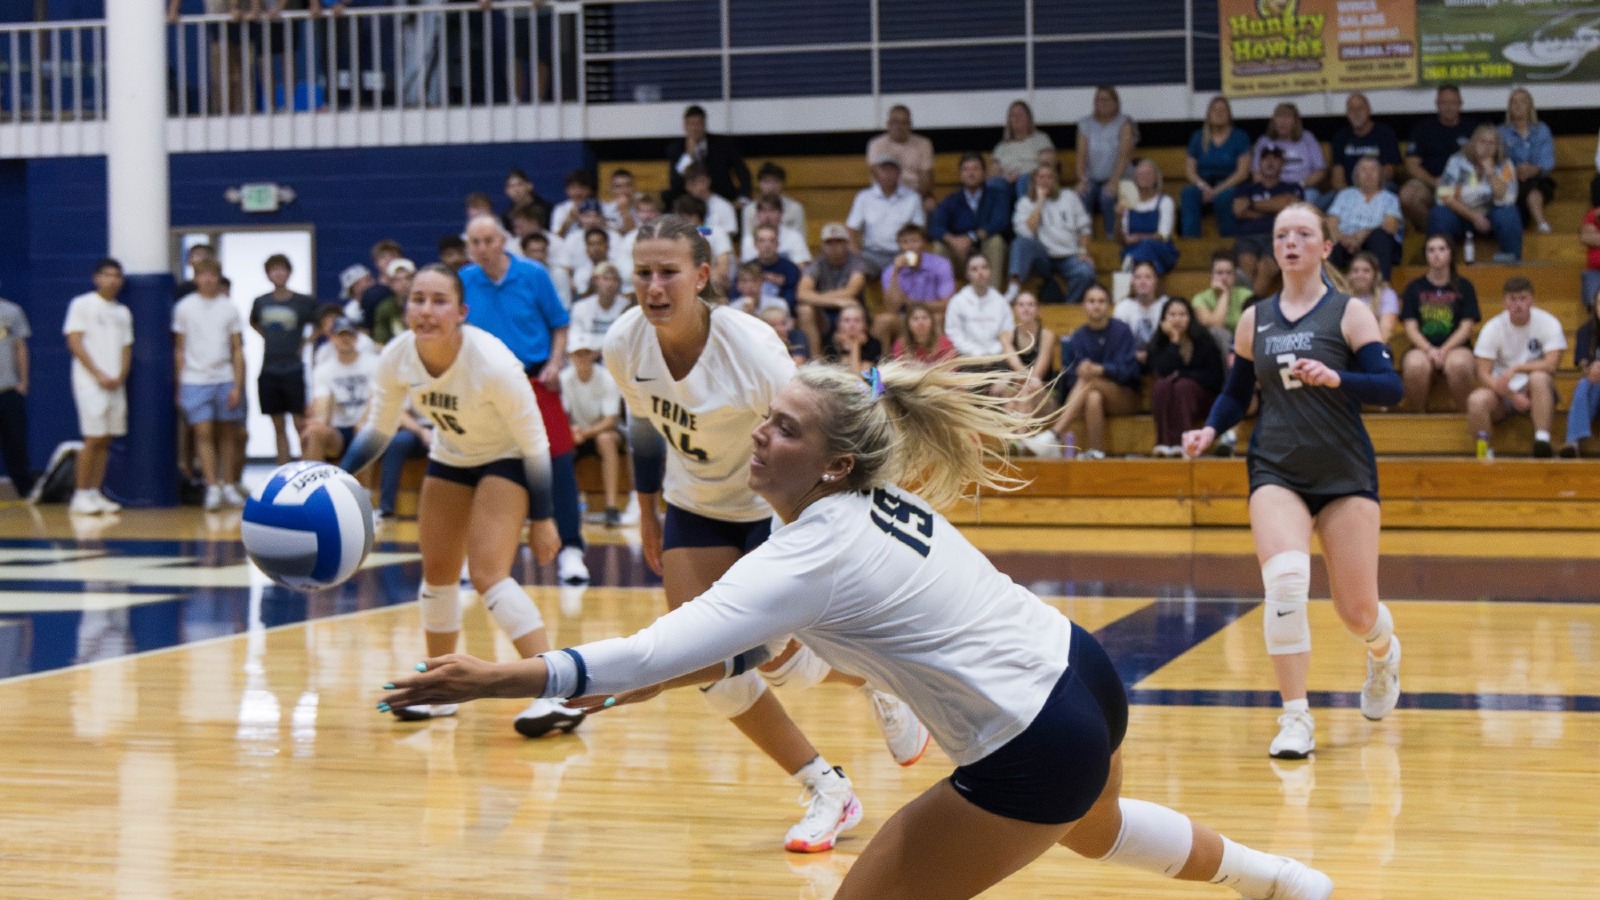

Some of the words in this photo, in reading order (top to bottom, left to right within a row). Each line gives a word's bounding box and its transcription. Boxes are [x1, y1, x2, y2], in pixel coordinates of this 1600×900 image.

[1229, 14, 1325, 41] Hungry
[1265, 331, 1315, 355] TRINE
[1276, 353, 1304, 391] 2
[421, 391, 459, 412] TRINE
[651, 395, 698, 431] TRINE
[431, 412, 467, 435] 16
[662, 423, 709, 462] 14
[869, 486, 934, 559] 19
